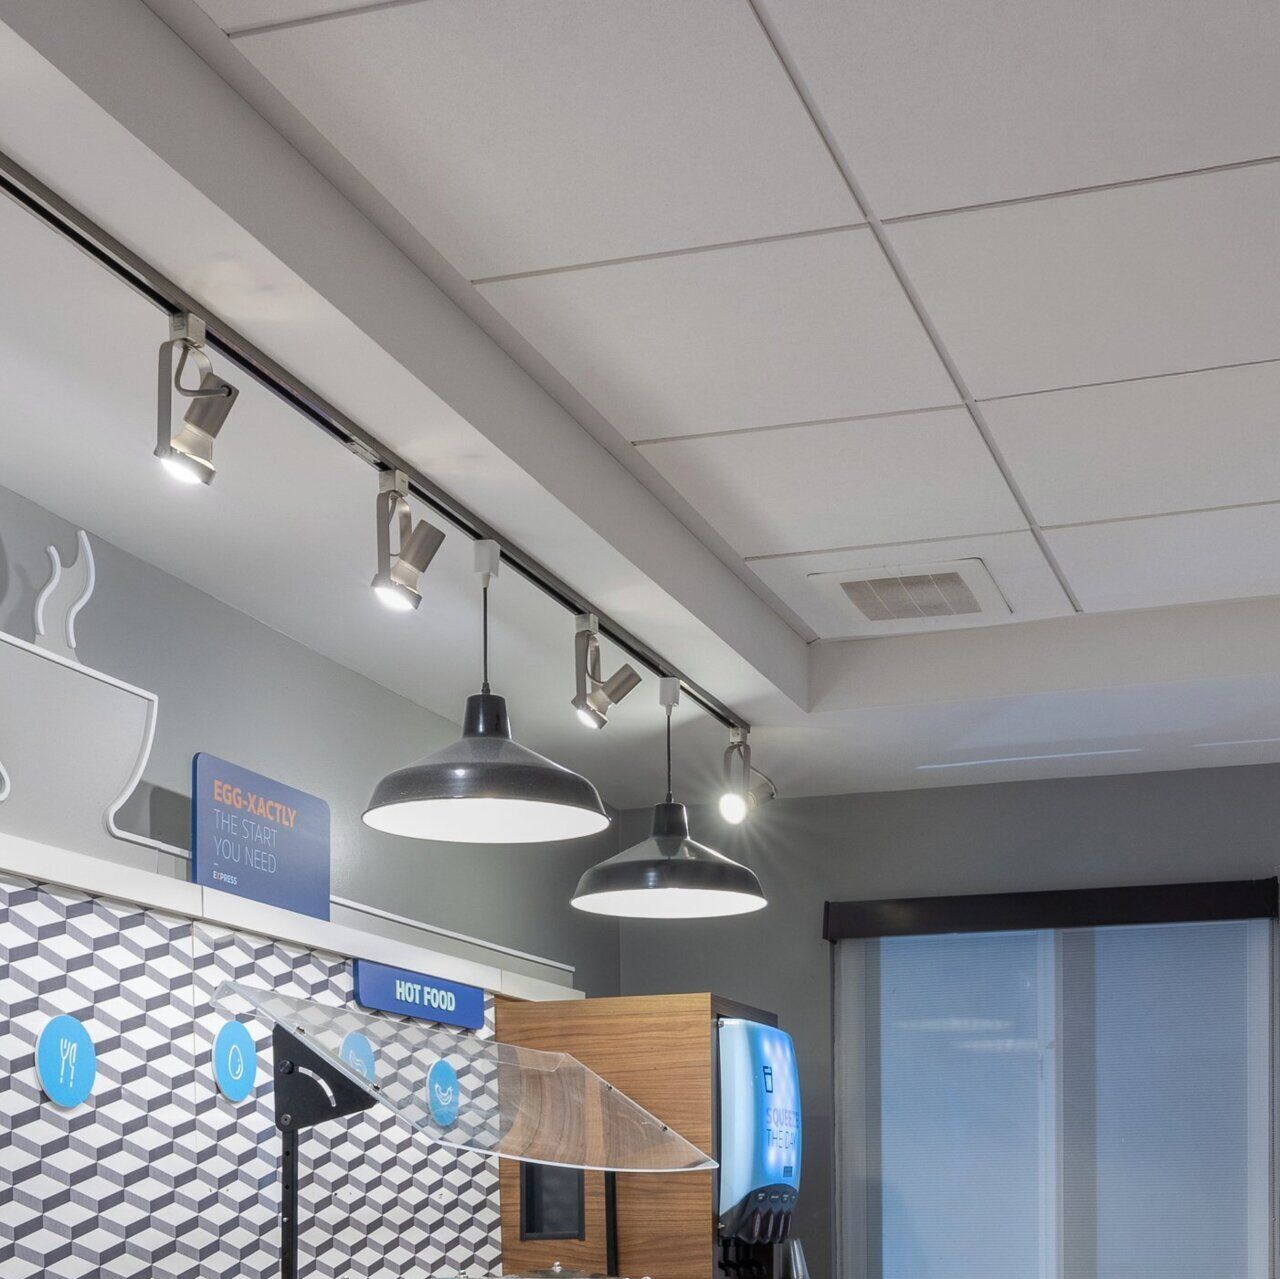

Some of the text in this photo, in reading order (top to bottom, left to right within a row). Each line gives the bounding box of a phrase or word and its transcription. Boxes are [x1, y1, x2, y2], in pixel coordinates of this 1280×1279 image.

[213, 779, 298, 828] EGG-XACTLY
[213, 808, 277, 848] THE START
[213, 836, 277, 874] YOU NEED
[213, 870, 238, 885] EXPRESS
[395, 979, 456, 1012] HOT FOOD
[766, 1108, 800, 1128] SQUEEZE
[766, 1129, 783, 1148] THE
